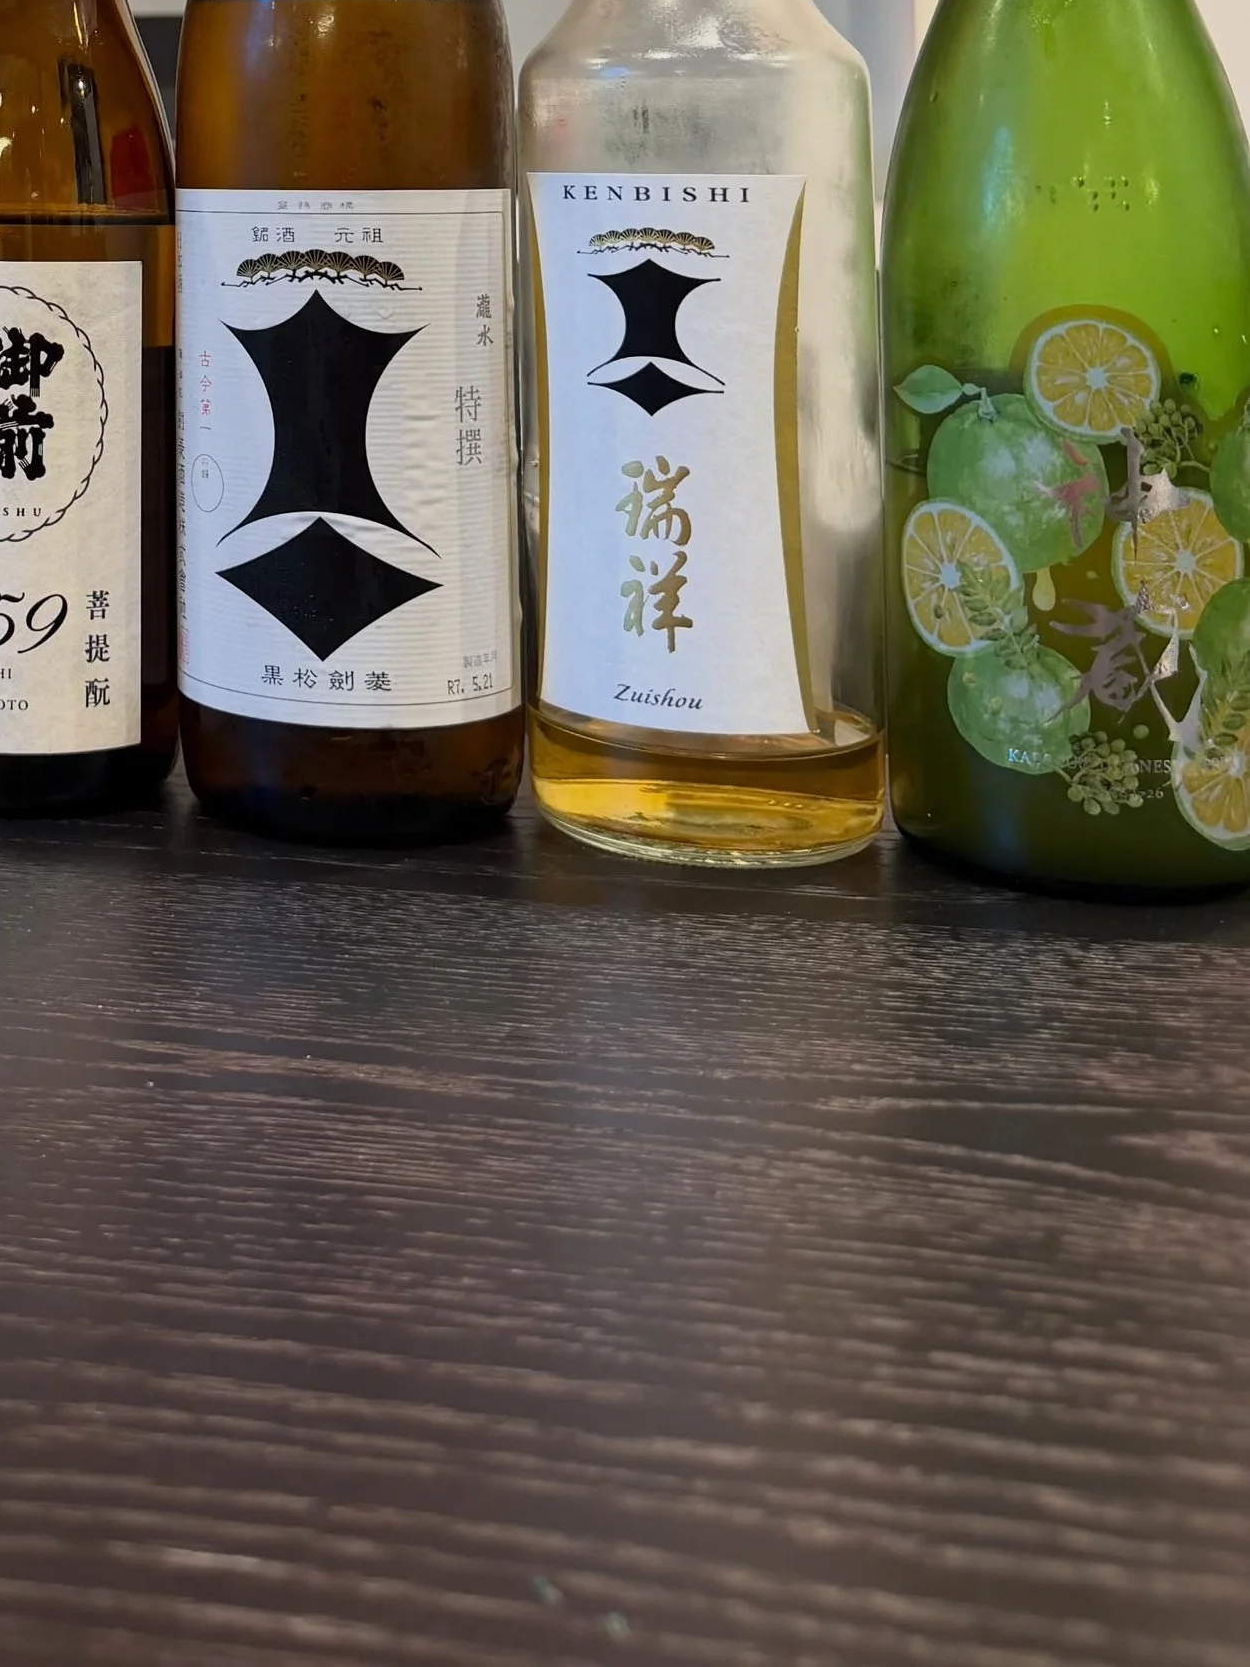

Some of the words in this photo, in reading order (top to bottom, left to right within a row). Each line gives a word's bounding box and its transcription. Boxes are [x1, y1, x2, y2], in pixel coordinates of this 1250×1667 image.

[562, 184, 751, 203] KENBISHI
[251, 226, 295, 244] 銘酒
[334, 227, 383, 244] 元祖
[454, 385, 483, 466] 特撰
[614, 455, 694, 654] 瑞祥
[613, 683, 704, 710] Zuishou
